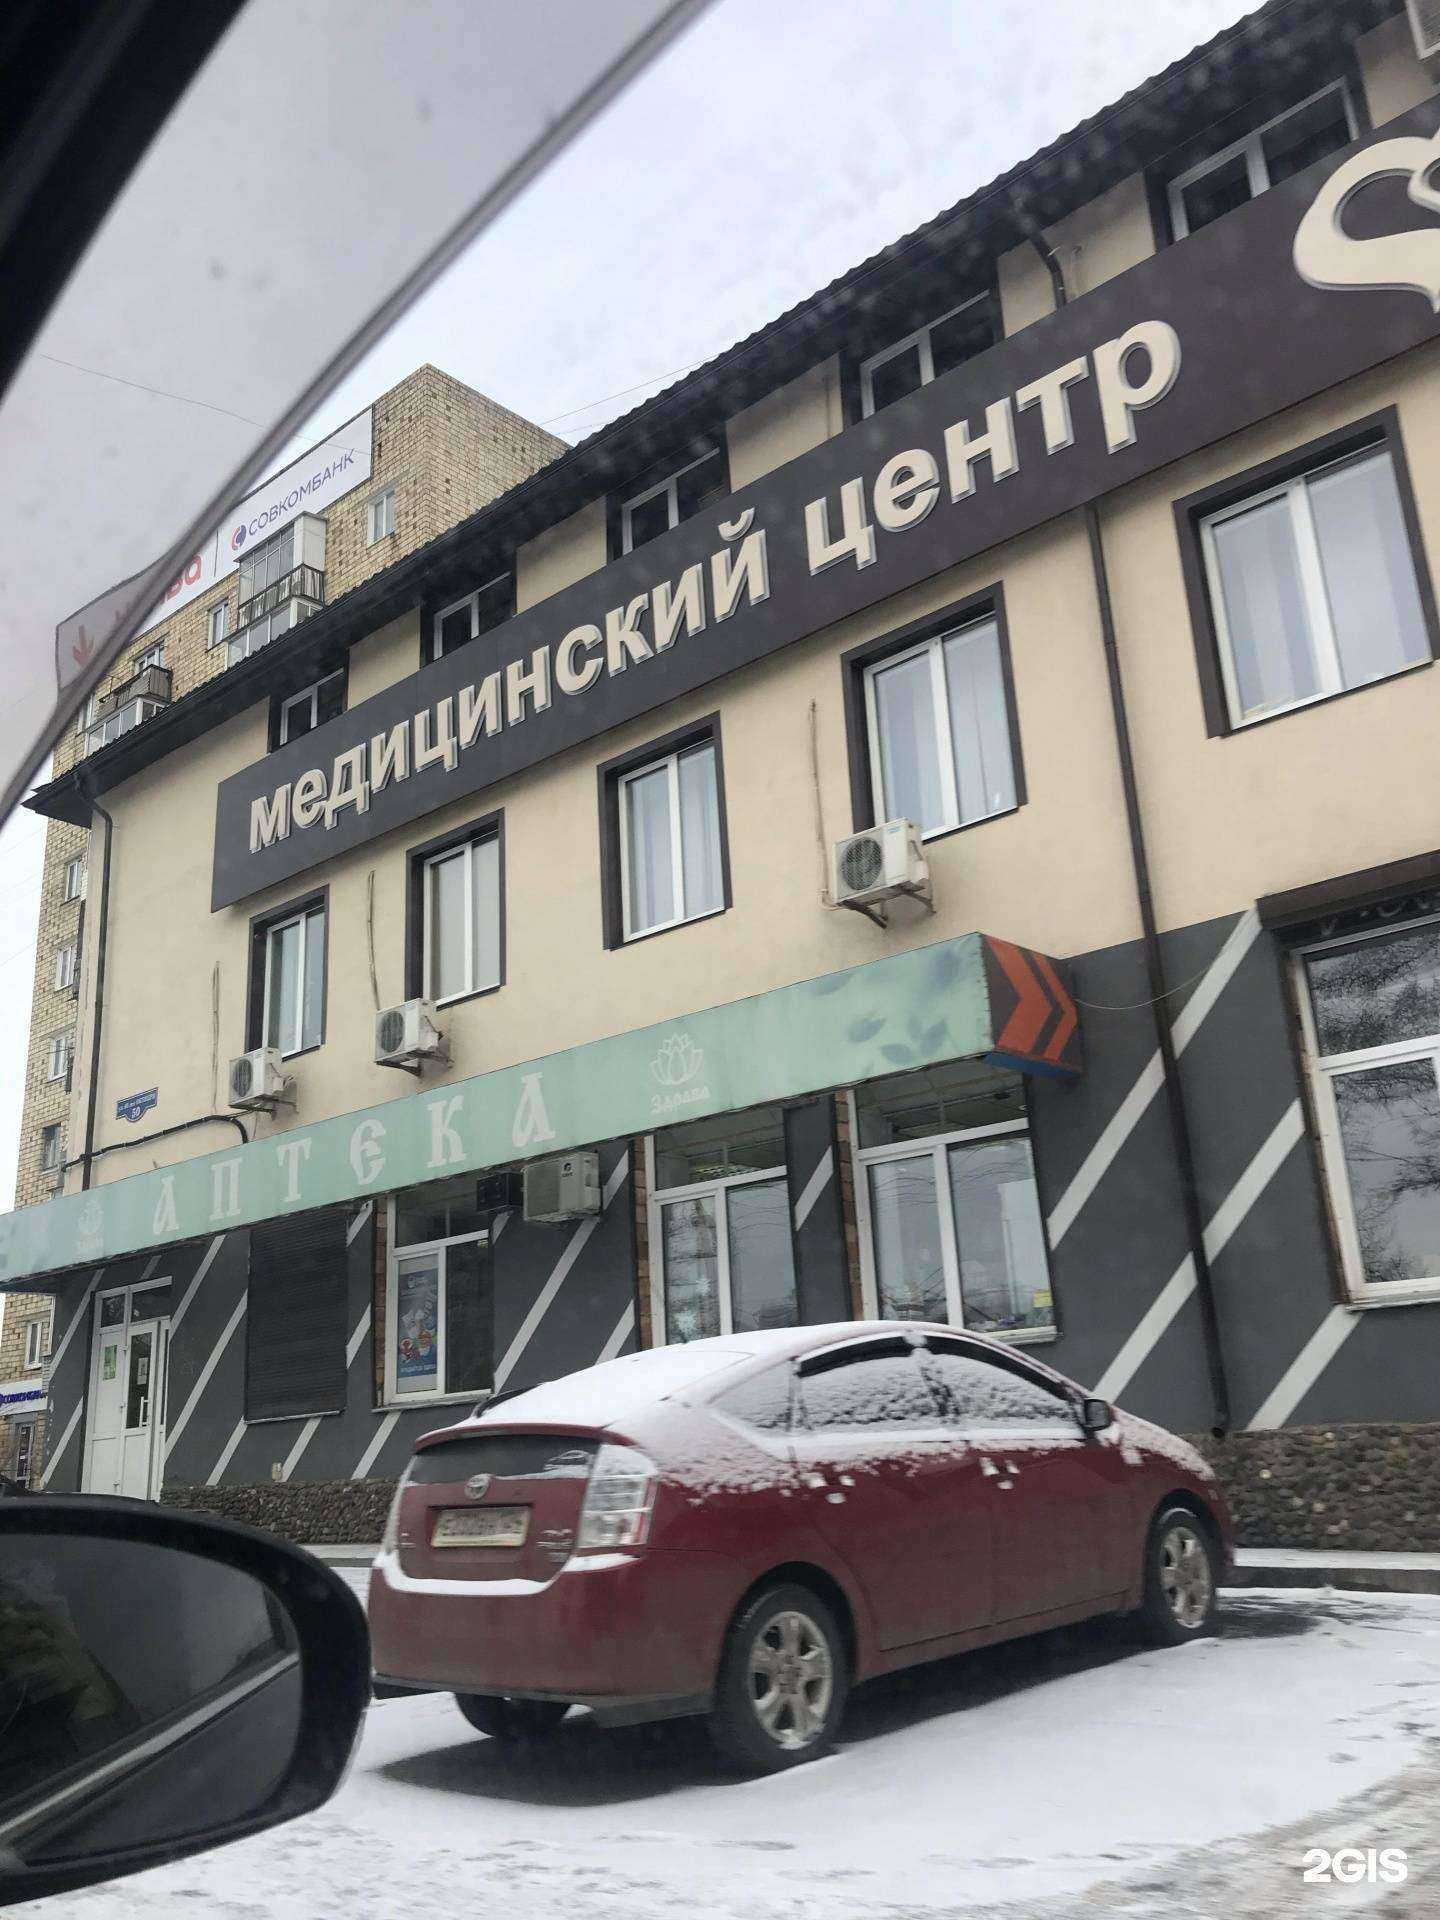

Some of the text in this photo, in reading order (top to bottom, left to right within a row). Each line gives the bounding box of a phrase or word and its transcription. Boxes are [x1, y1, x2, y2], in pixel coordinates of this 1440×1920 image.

[249, 448, 355, 536] СОВКОМБАНК
[249, 320, 1182, 854] медицинский центр
[152, 1071, 556, 1236] АПТЕКА
